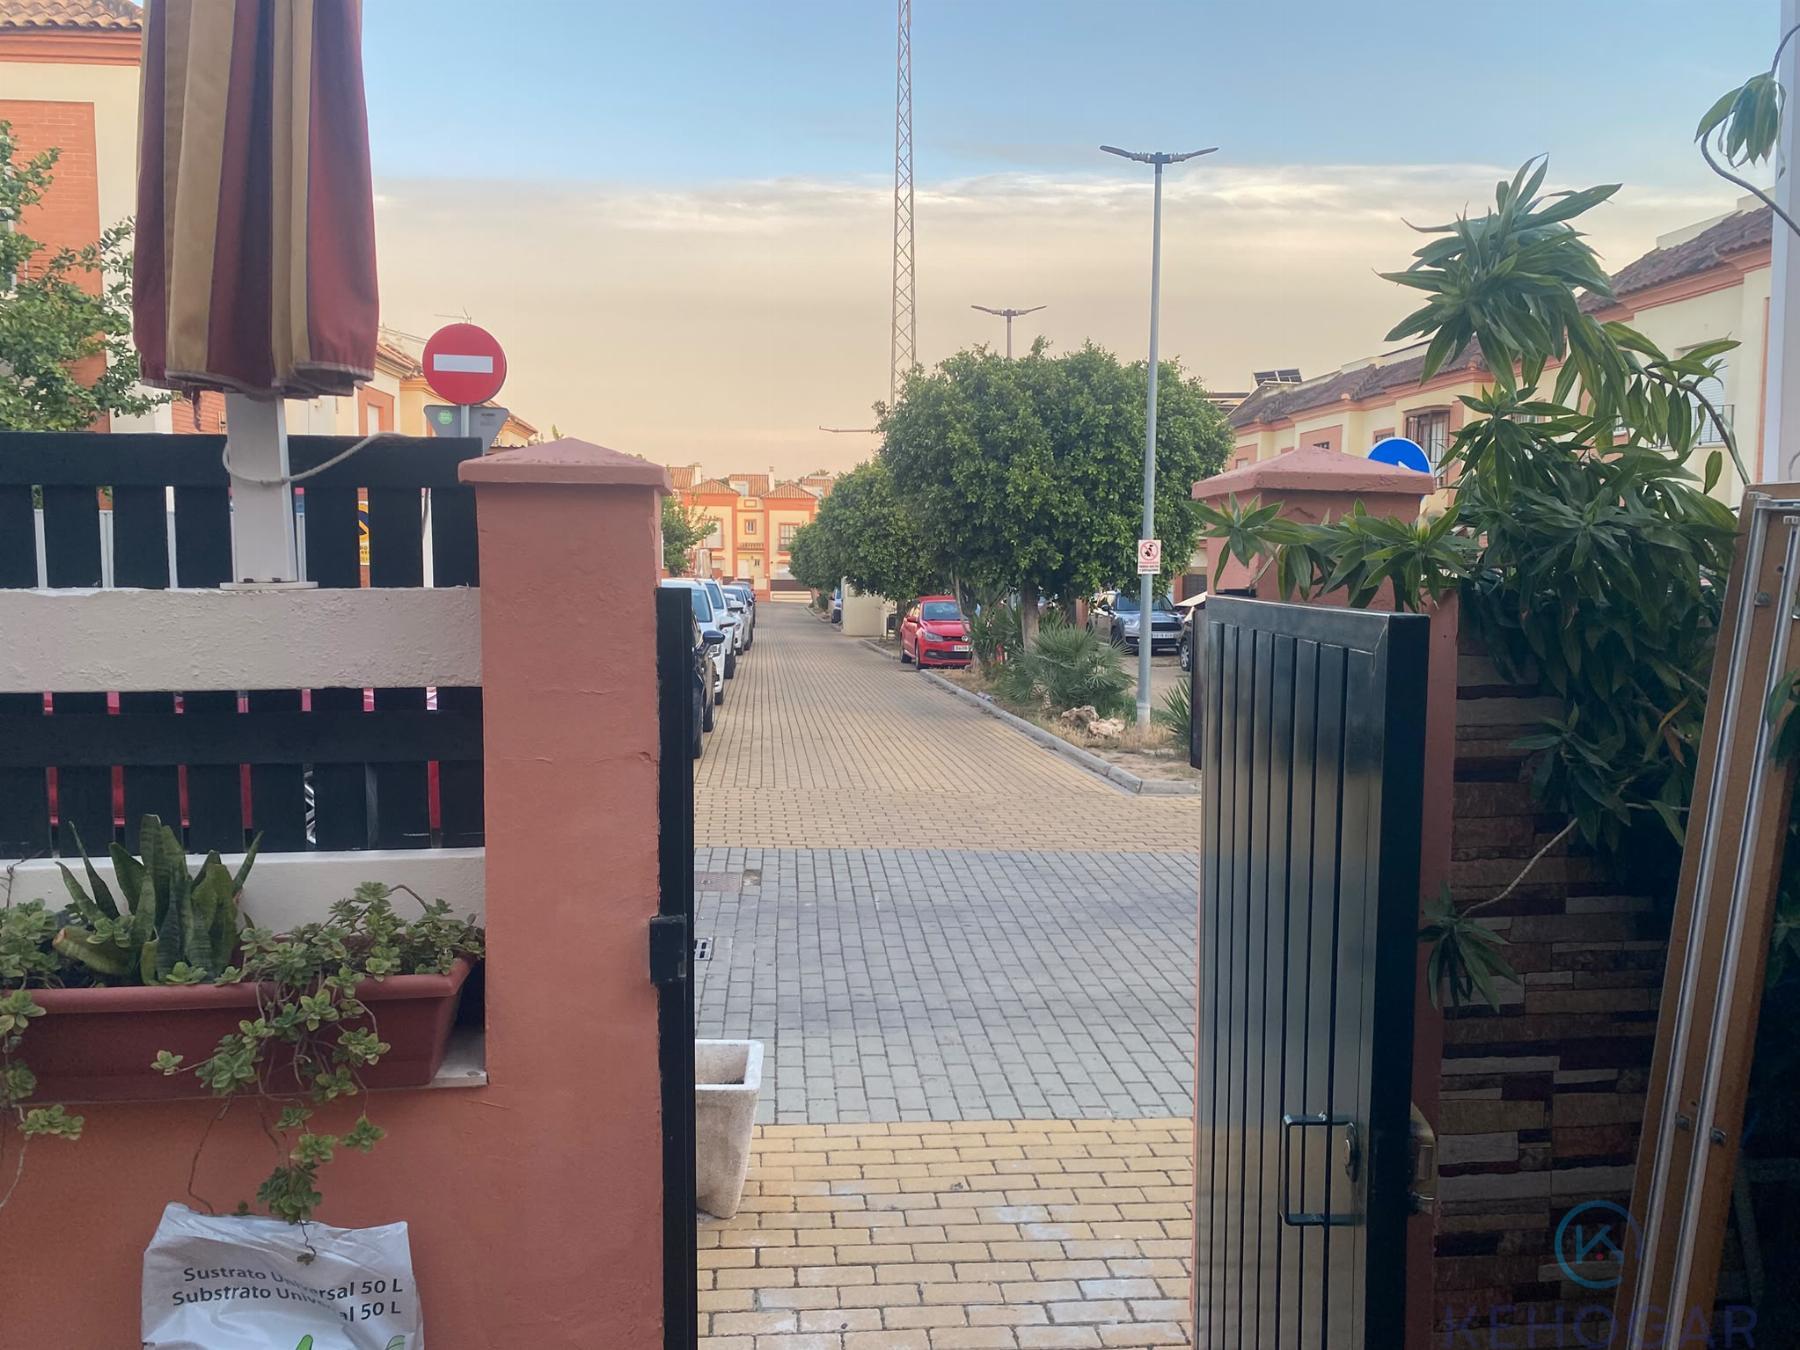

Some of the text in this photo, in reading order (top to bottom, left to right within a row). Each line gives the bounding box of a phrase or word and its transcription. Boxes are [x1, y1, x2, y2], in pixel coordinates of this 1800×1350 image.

[183, 1266, 266, 1282] Sustrato
[361, 1280, 386, 1295] 50
[392, 1278, 403, 1293] L
[172, 1285, 271, 1306] Substrato
[360, 1301, 385, 1320] 50
[391, 1300, 401, 1314] L
